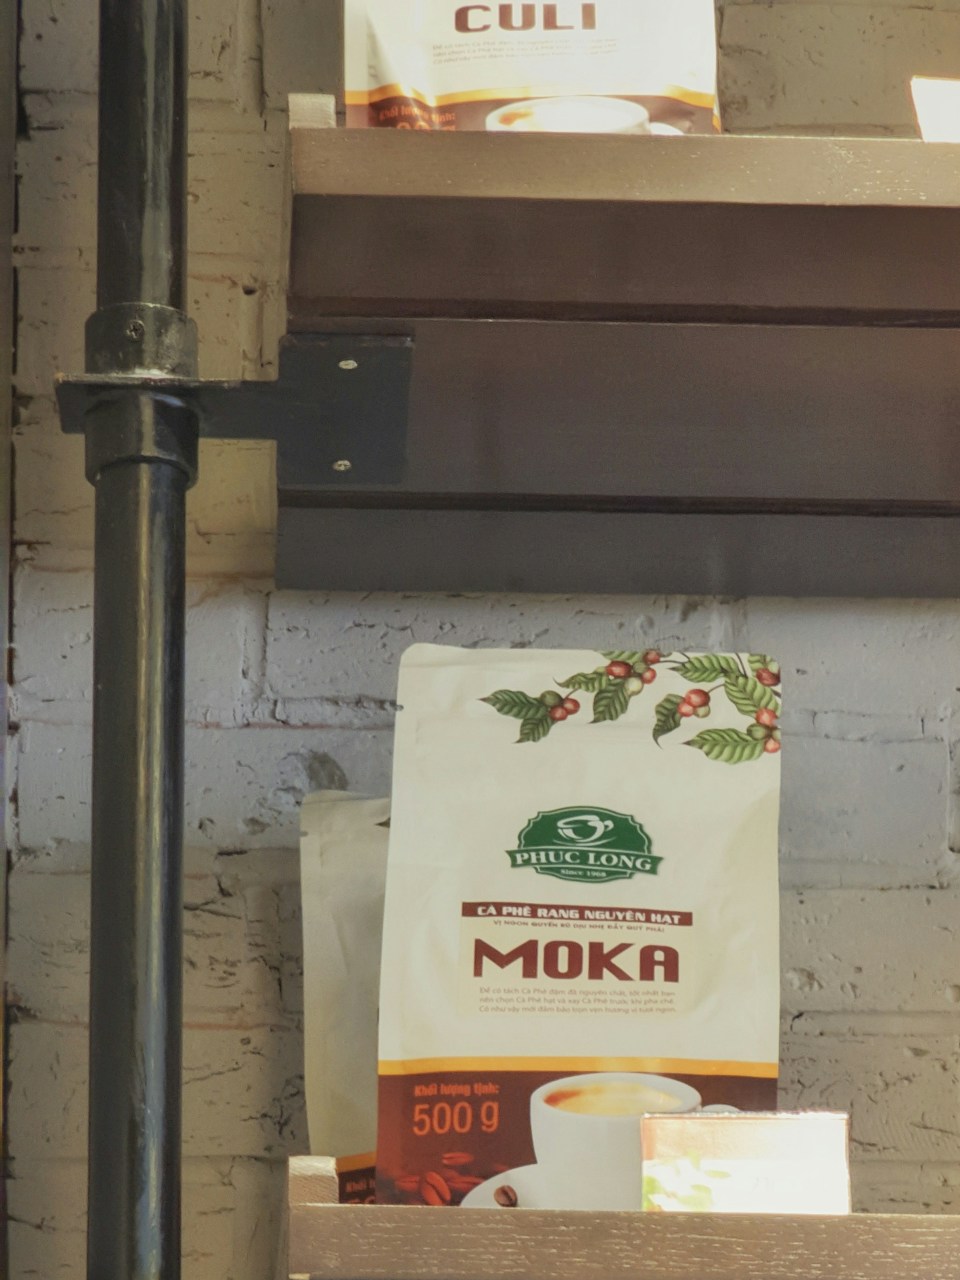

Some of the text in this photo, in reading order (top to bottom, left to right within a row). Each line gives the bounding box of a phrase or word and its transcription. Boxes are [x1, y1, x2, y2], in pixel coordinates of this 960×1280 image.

[454, 3, 596, 33] CULI
[515, 850, 652, 871] PHUC LONG
[477, 904, 681, 926] CÀ PHÊ RANG NGUYÊN HẠT
[473, 938, 679, 983] MOKA
[412, 1101, 499, 1136] 500 g
